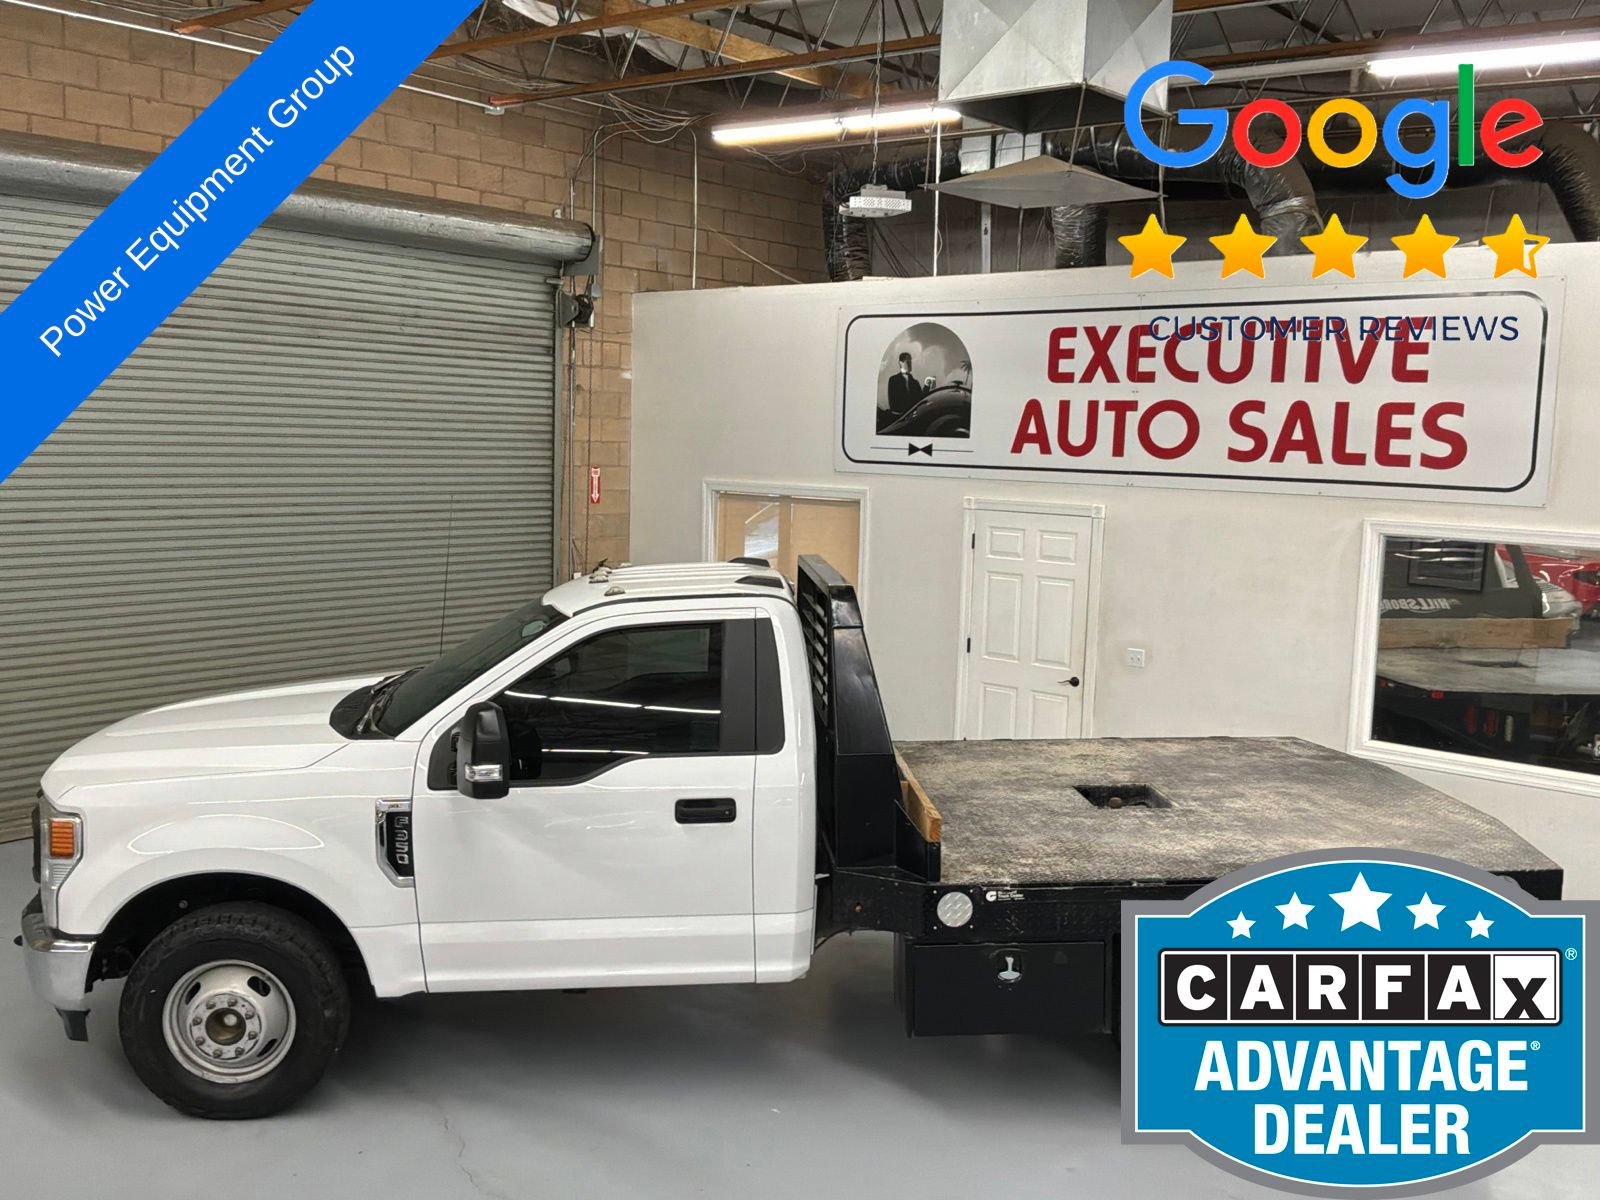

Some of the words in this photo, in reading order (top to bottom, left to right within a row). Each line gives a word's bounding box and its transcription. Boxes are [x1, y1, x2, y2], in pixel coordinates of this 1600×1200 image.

[1047, 317, 1432, 385] EXECUTIVE
[1010, 398, 1200, 460] AUTO
[1227, 400, 1468, 470] SALES
